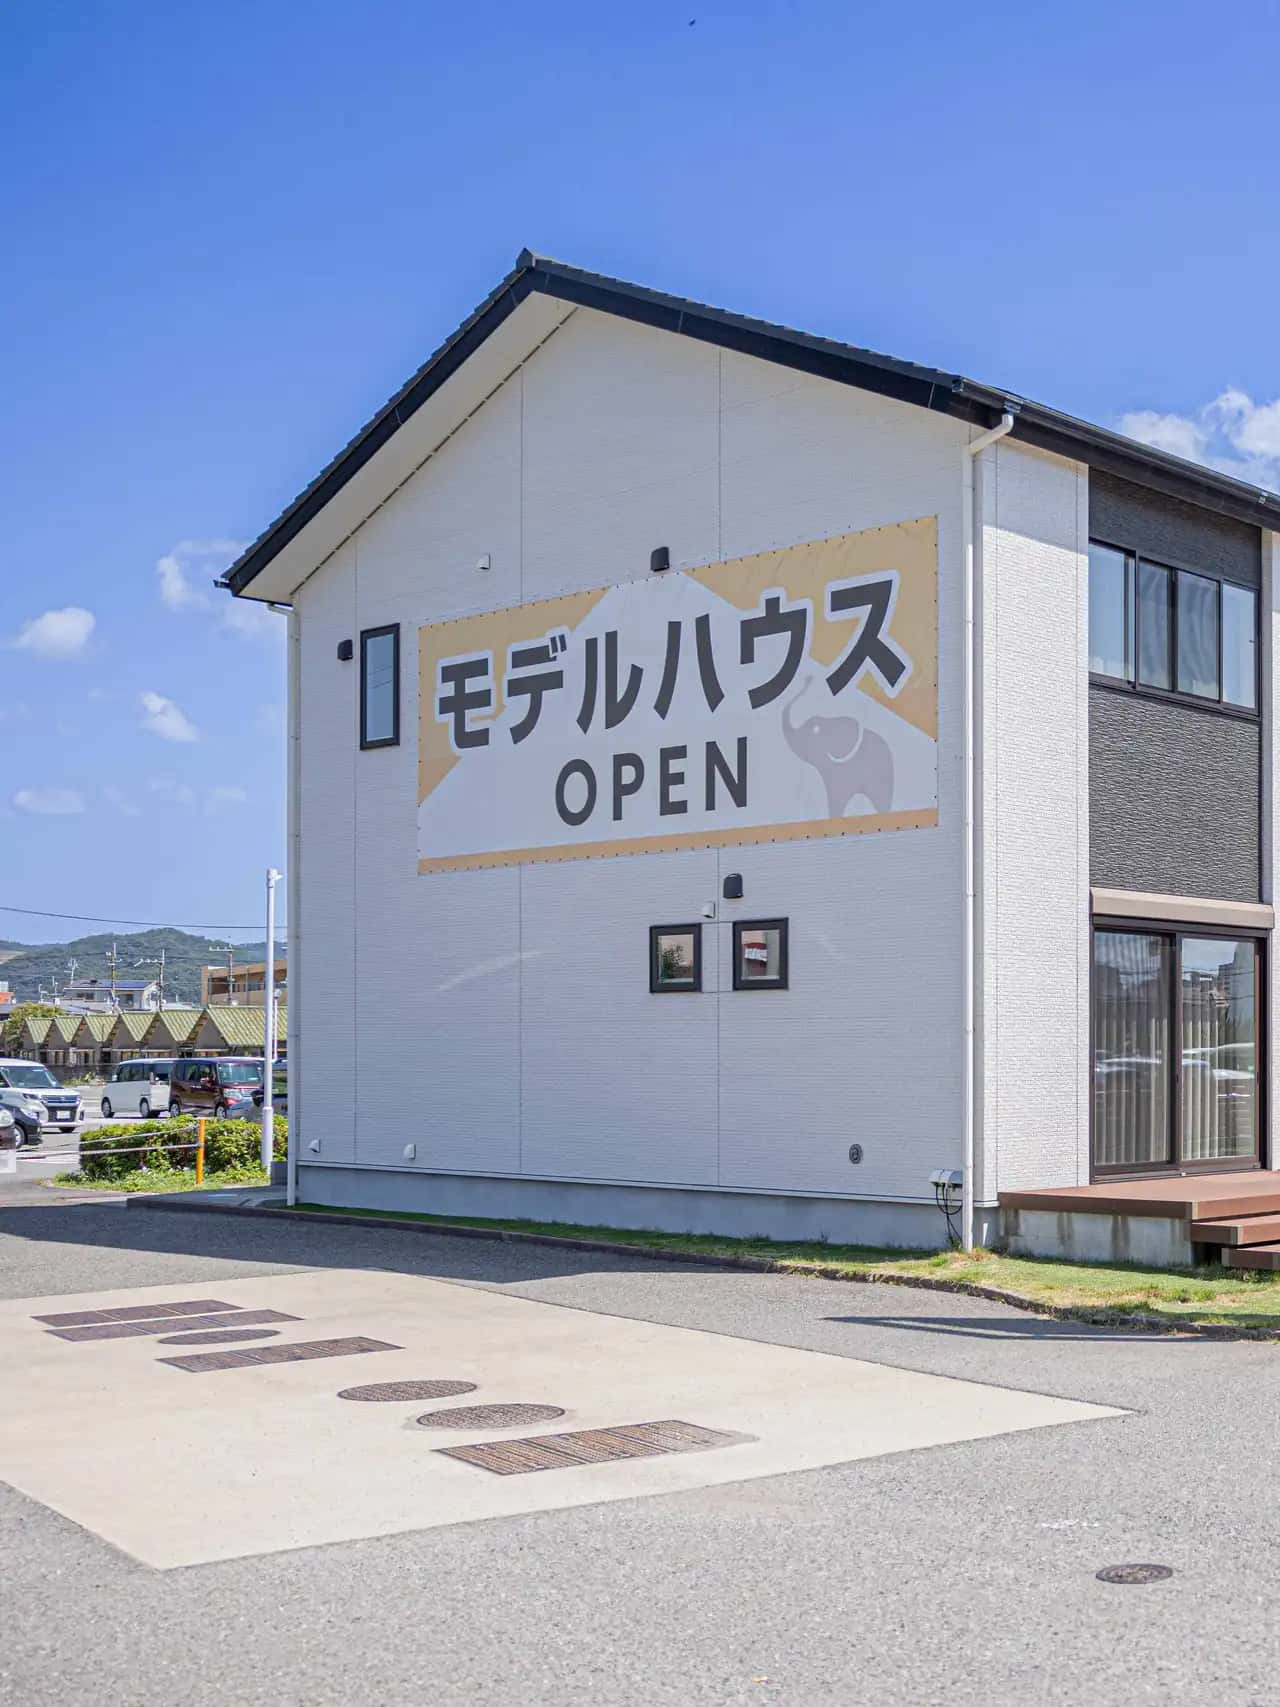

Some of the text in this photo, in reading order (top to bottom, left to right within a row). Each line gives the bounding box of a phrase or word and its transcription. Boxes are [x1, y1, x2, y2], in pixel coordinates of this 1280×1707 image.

[438, 579, 907, 750] モデルハウス
[555, 736, 748, 826] OPEN
